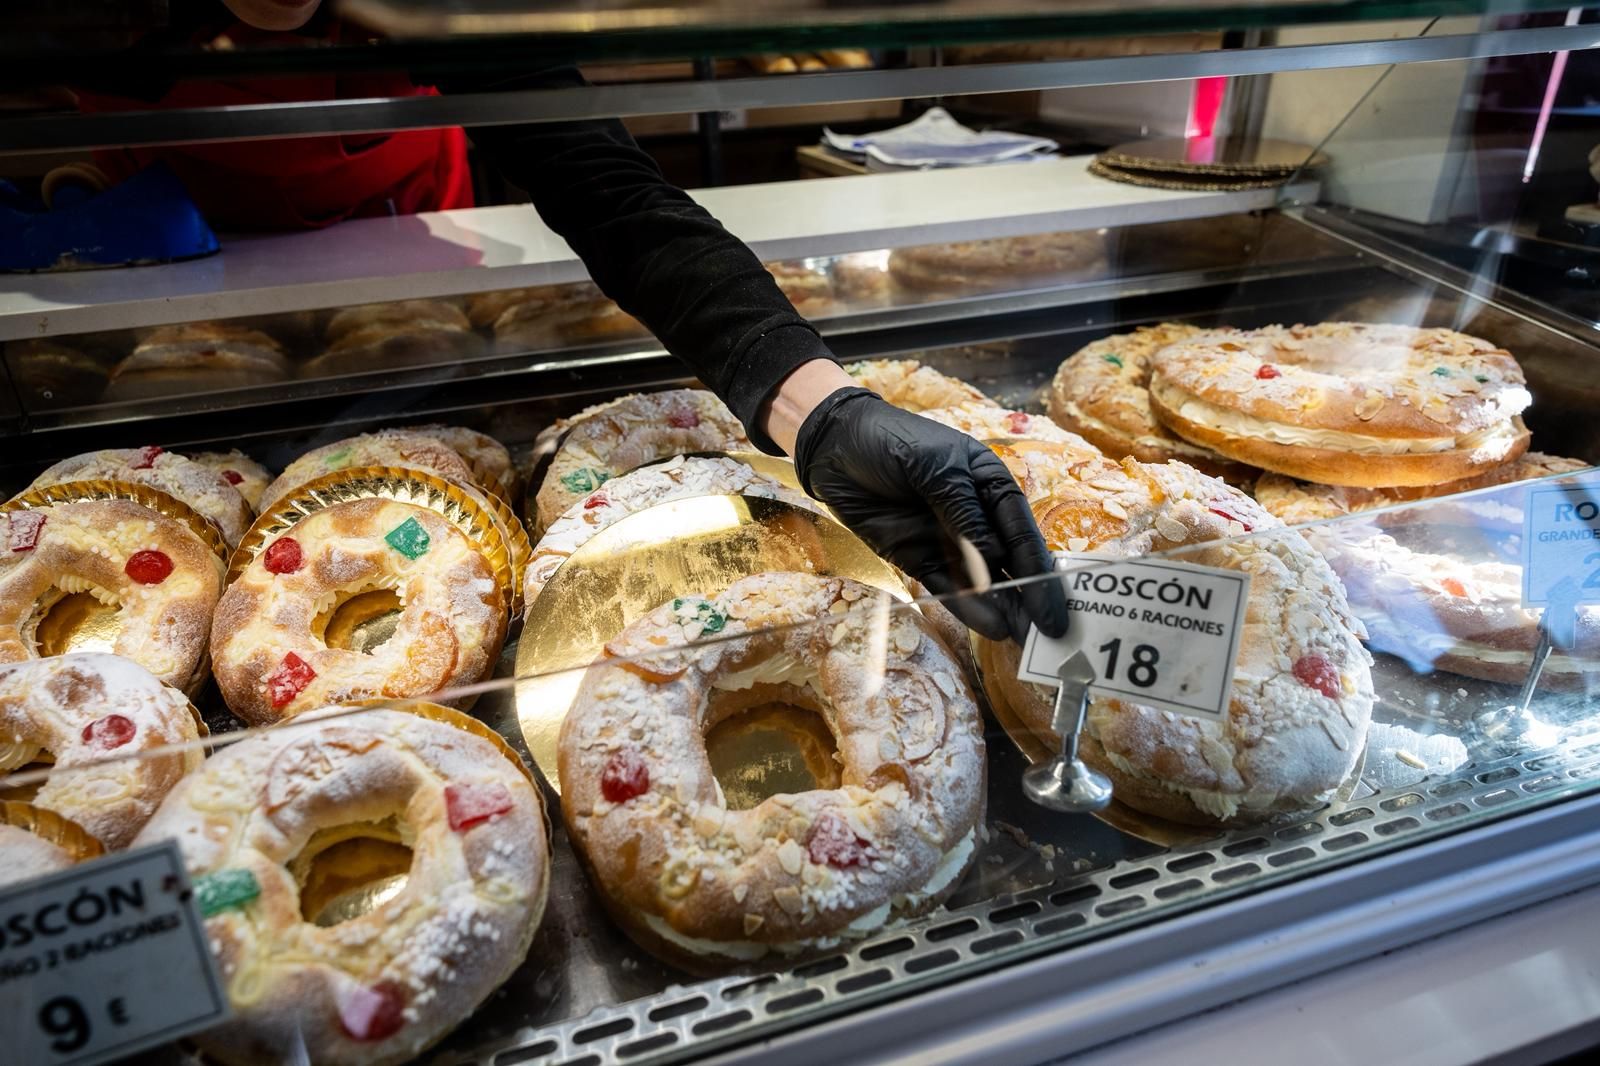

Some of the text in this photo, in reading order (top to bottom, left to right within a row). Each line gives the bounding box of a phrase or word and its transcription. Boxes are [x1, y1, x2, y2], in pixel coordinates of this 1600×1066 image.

[1072, 571, 1213, 610] ROSCÓN
[1066, 599, 1225, 636] EDIANO 6 RACIONES
[1098, 637, 1160, 688] 18
[0, 880, 145, 950] SCÓN
[38, 996, 92, 1053] 9
